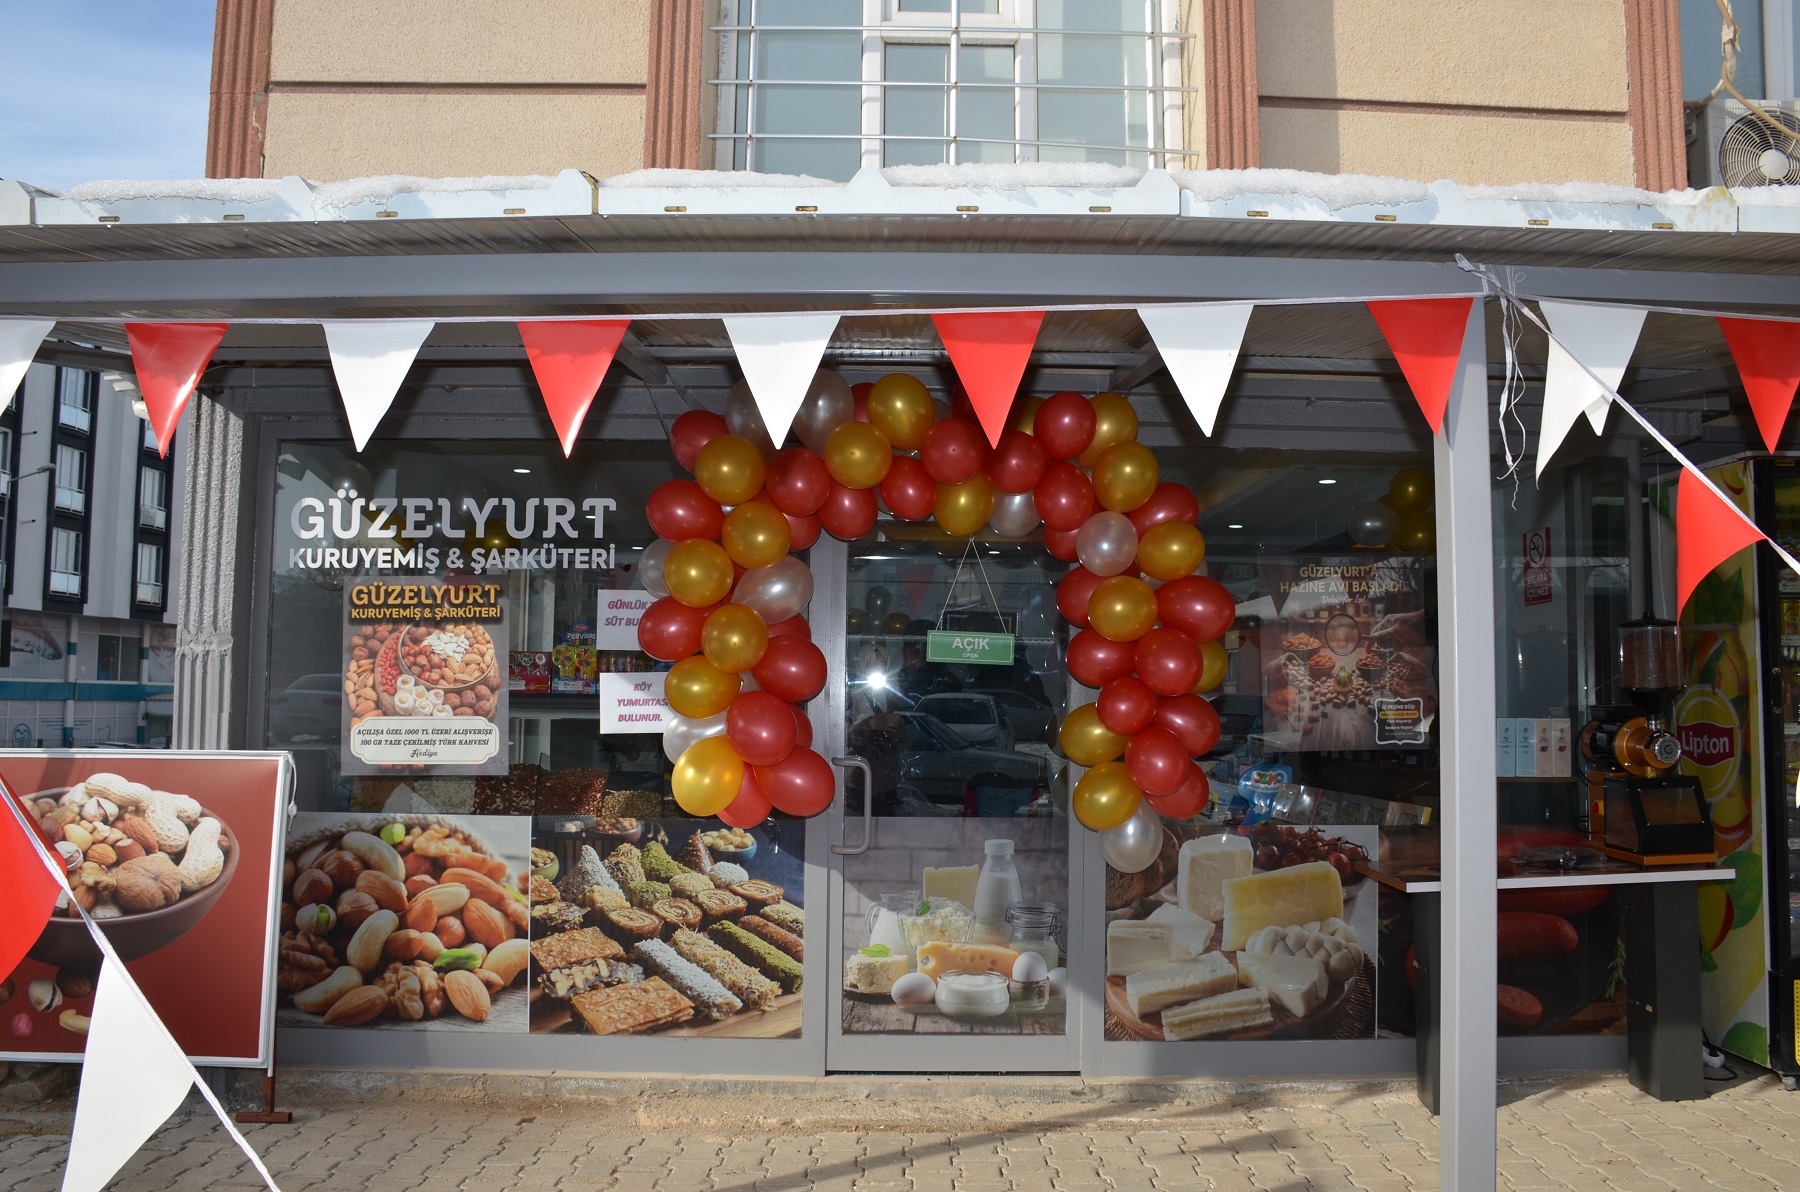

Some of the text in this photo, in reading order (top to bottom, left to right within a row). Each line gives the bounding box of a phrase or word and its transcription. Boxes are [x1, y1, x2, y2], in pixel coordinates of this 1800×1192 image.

[290, 488, 617, 540] GÜZELYURT
[289, 543, 616, 574] KURUYEMİŞ & ŞARKÜTERİ
[351, 581, 501, 605] GÜZELYURT
[1280, 578, 1326, 593] HAZİNE
[1328, 581, 1349, 593] AVI
[607, 599, 648, 610] GÜNLÜK
[351, 605, 501, 621] KURUYEMİŞ & ŞARKÜTERİ
[604, 617, 624, 627] SÜT
[952, 636, 990, 653] AÇIK
[633, 681, 653, 692] KÖY
[617, 714, 663, 723] BULUNUR.
[356, 728, 384, 737] AÇILIŞA
[385, 727, 403, 735] ÖZEL
[431, 727, 452, 735] ÜZERİ
[453, 727, 494, 737] ALIŞVERİŞE
[403, 738, 437, 747] ÇEKİLMİŞ
[438, 738, 457, 746] TÜRK
[458, 738, 490, 746] KAHVESİ
[1681, 730, 1730, 758] Lipton
